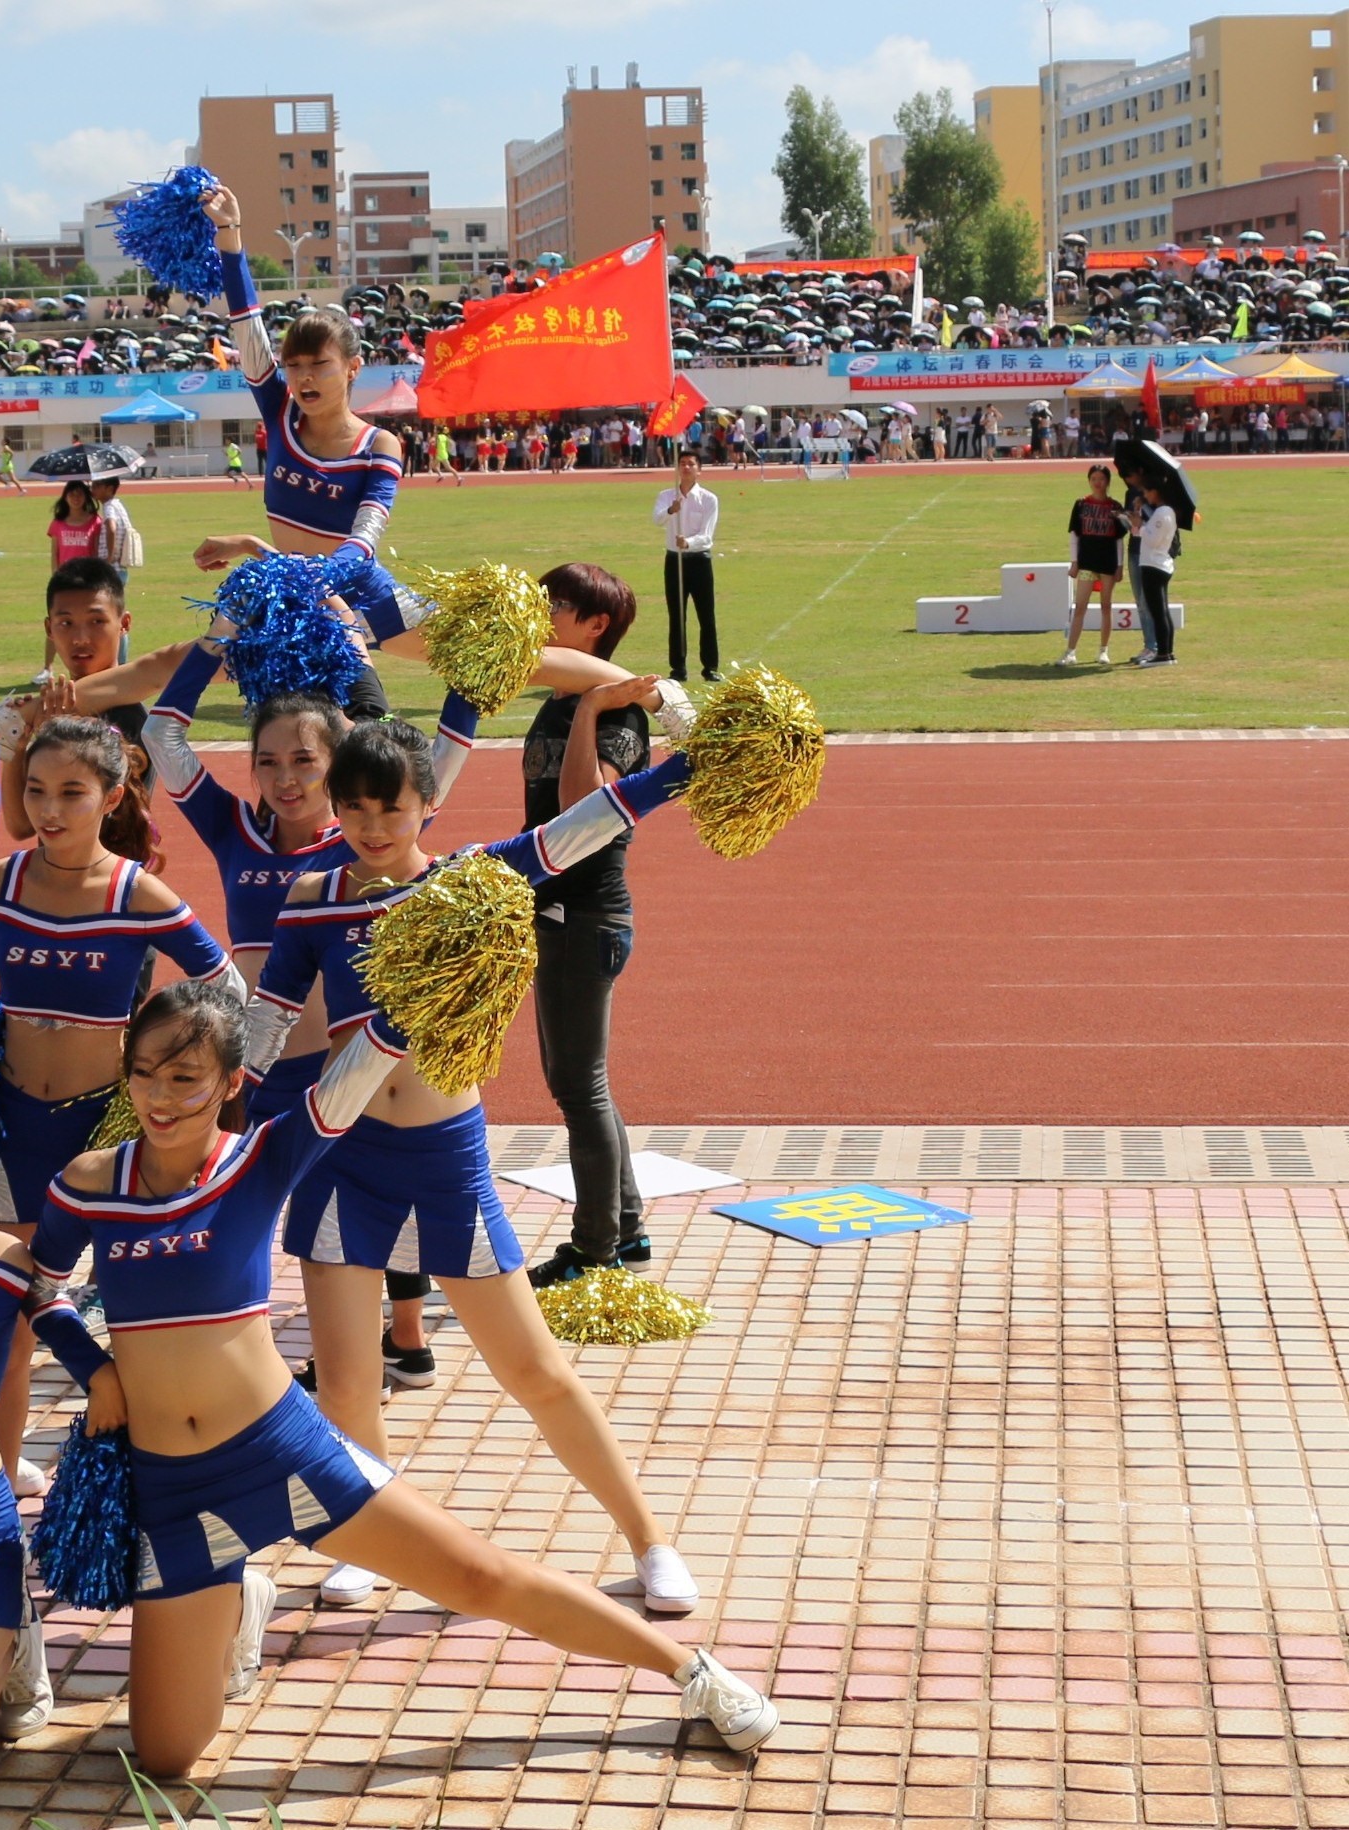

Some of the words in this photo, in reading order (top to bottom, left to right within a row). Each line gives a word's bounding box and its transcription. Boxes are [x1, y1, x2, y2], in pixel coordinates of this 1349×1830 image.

[895, 353, 1044, 373] 体坛青春际会
[273, 465, 344, 499] SSYT
[954, 604, 969, 625] 2
[1117, 609, 1132, 629] 3
[237, 869, 308, 885] SSY
[6, 946, 107, 970] SSYT
[108, 1230, 211, 1261] SSYT
